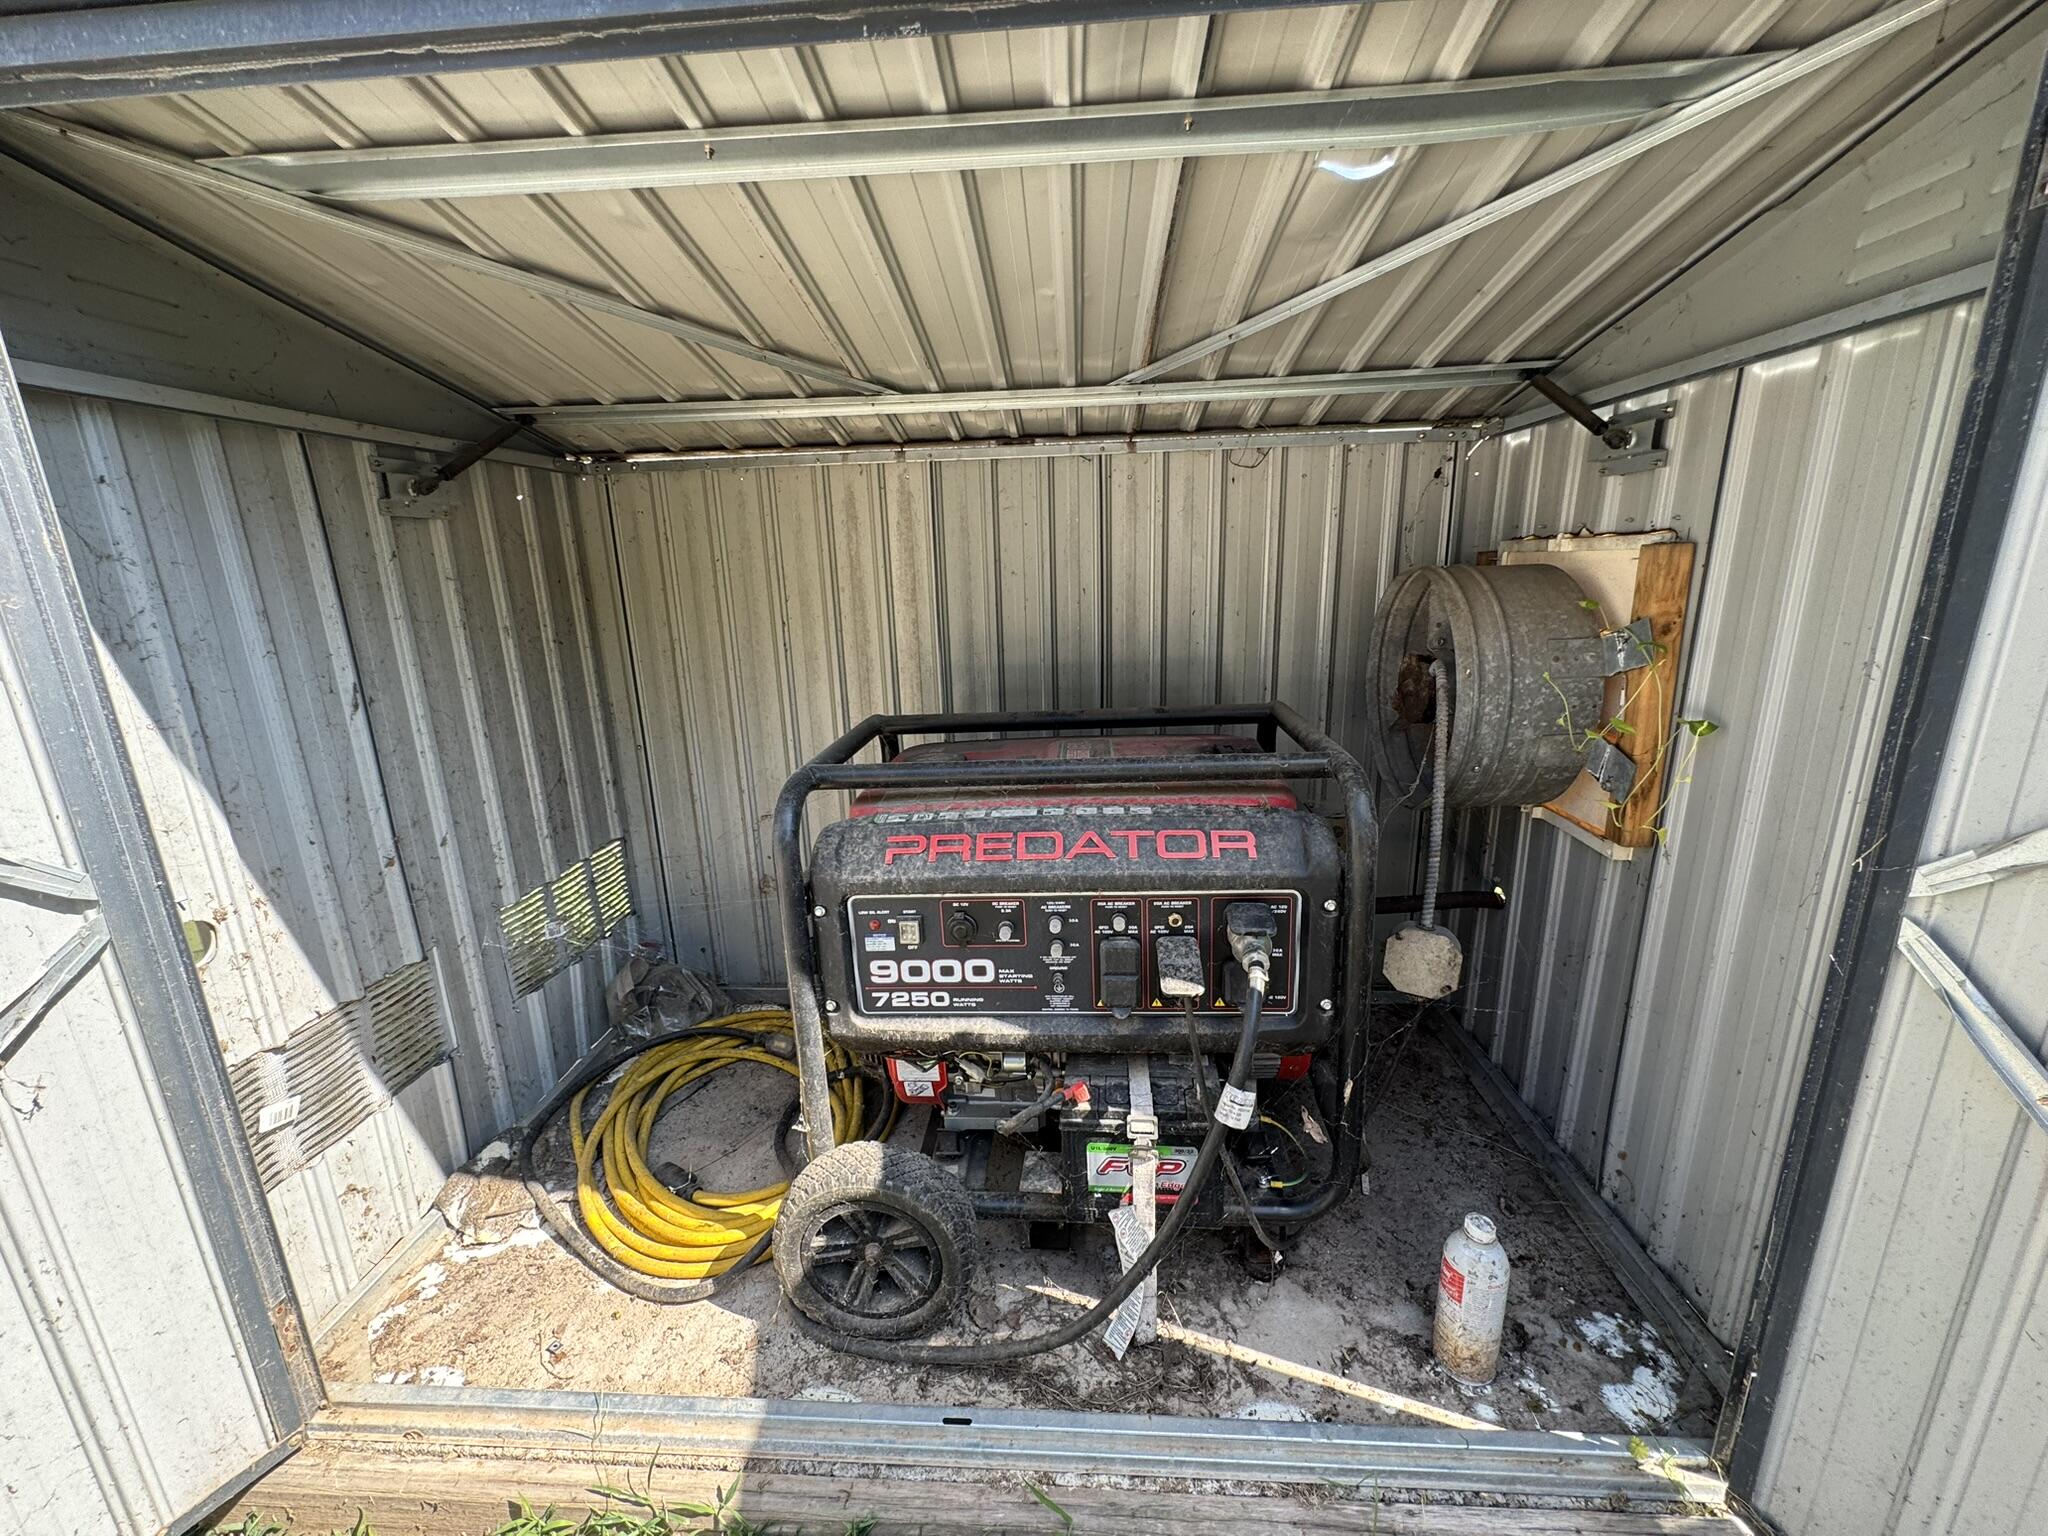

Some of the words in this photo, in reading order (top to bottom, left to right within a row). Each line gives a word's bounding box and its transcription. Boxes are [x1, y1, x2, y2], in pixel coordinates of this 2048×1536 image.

[885, 829, 1257, 864] PREDATOR
[870, 958, 995, 983] 9000
[871, 991, 950, 1007] 7250
[1096, 1156, 1187, 1177] FP
